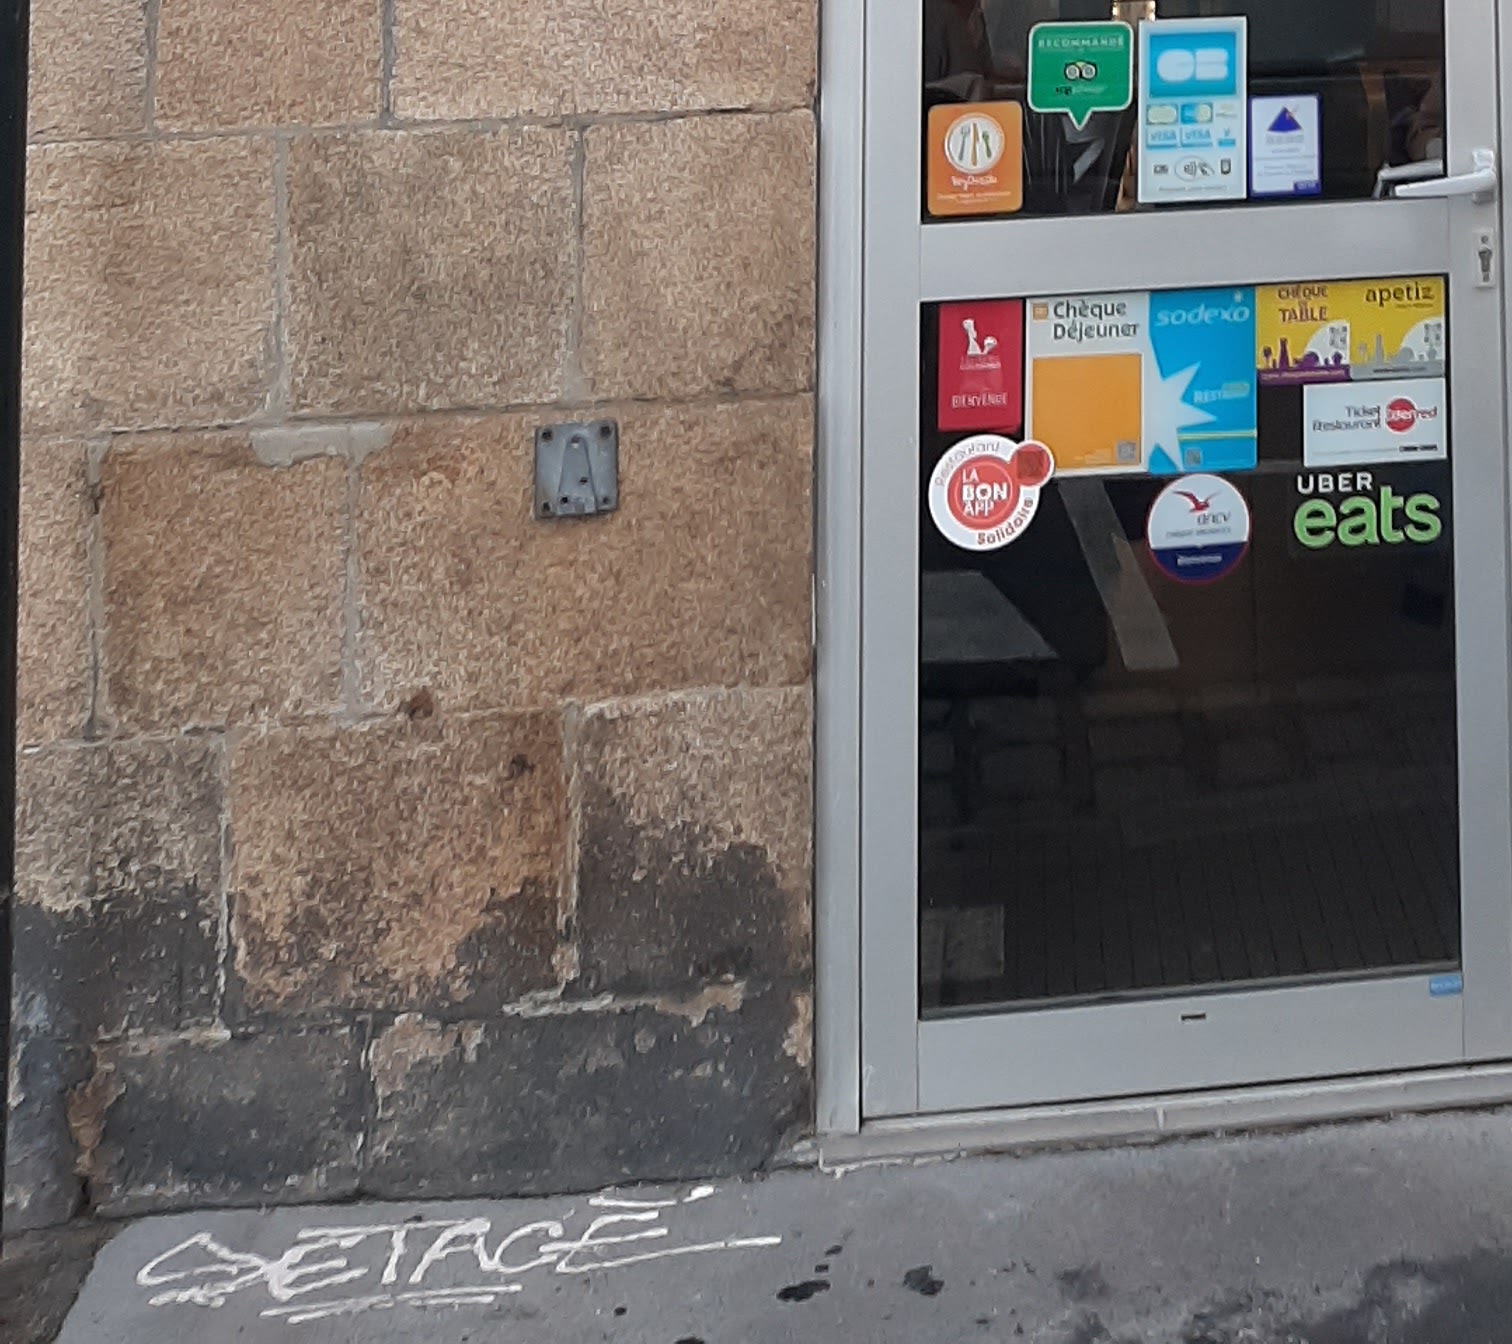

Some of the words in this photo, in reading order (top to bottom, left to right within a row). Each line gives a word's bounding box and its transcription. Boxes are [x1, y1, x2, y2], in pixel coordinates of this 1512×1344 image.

[1365, 281, 1435, 308] apetiz
[1053, 298, 1127, 321] Chèque
[1154, 302, 1251, 328] sodexo
[1053, 319, 1141, 344] Déjeuner
[961, 468, 980, 484] LA
[1296, 472, 1374, 495] UBER
[961, 482, 1008, 502] BON
[1293, 484, 1443, 551] eats
